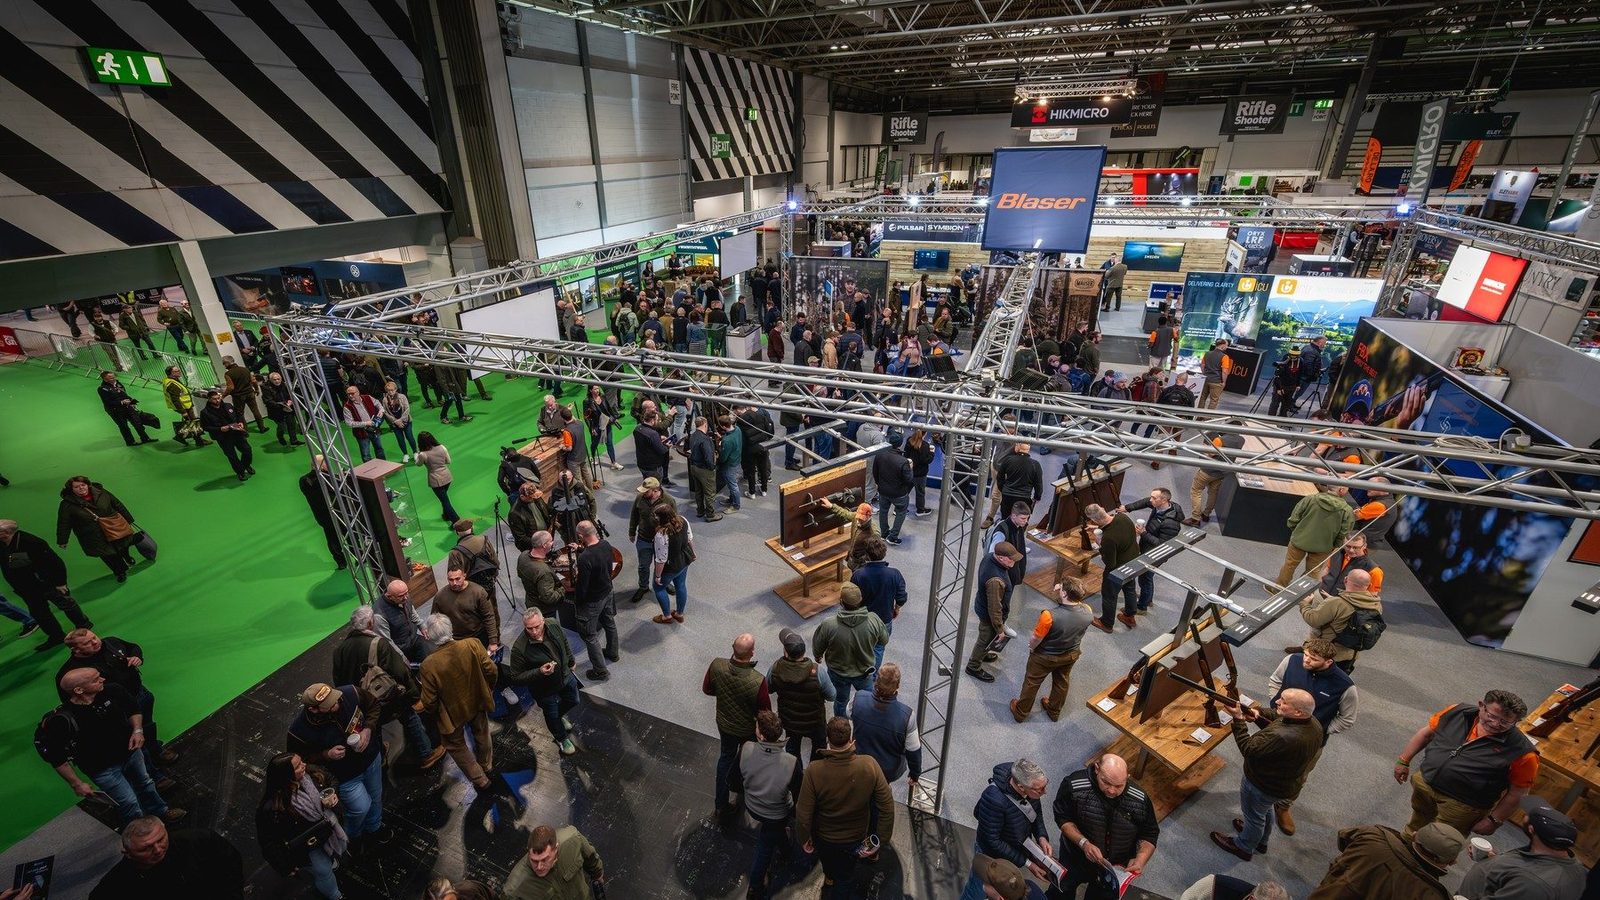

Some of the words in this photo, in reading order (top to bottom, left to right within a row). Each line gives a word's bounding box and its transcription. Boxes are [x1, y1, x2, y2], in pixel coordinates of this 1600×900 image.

[1050, 107, 1110, 120] HIKMICRO
[1237, 101, 1277, 116] Rifle
[1289, 103, 1303, 114] IT
[890, 117, 918, 129] Rifle
[1234, 116, 1275, 125] Shooter
[717, 141, 730, 151] EXIT
[996, 193, 1087, 210] Blaser
[1245, 236, 1264, 244] LRF
